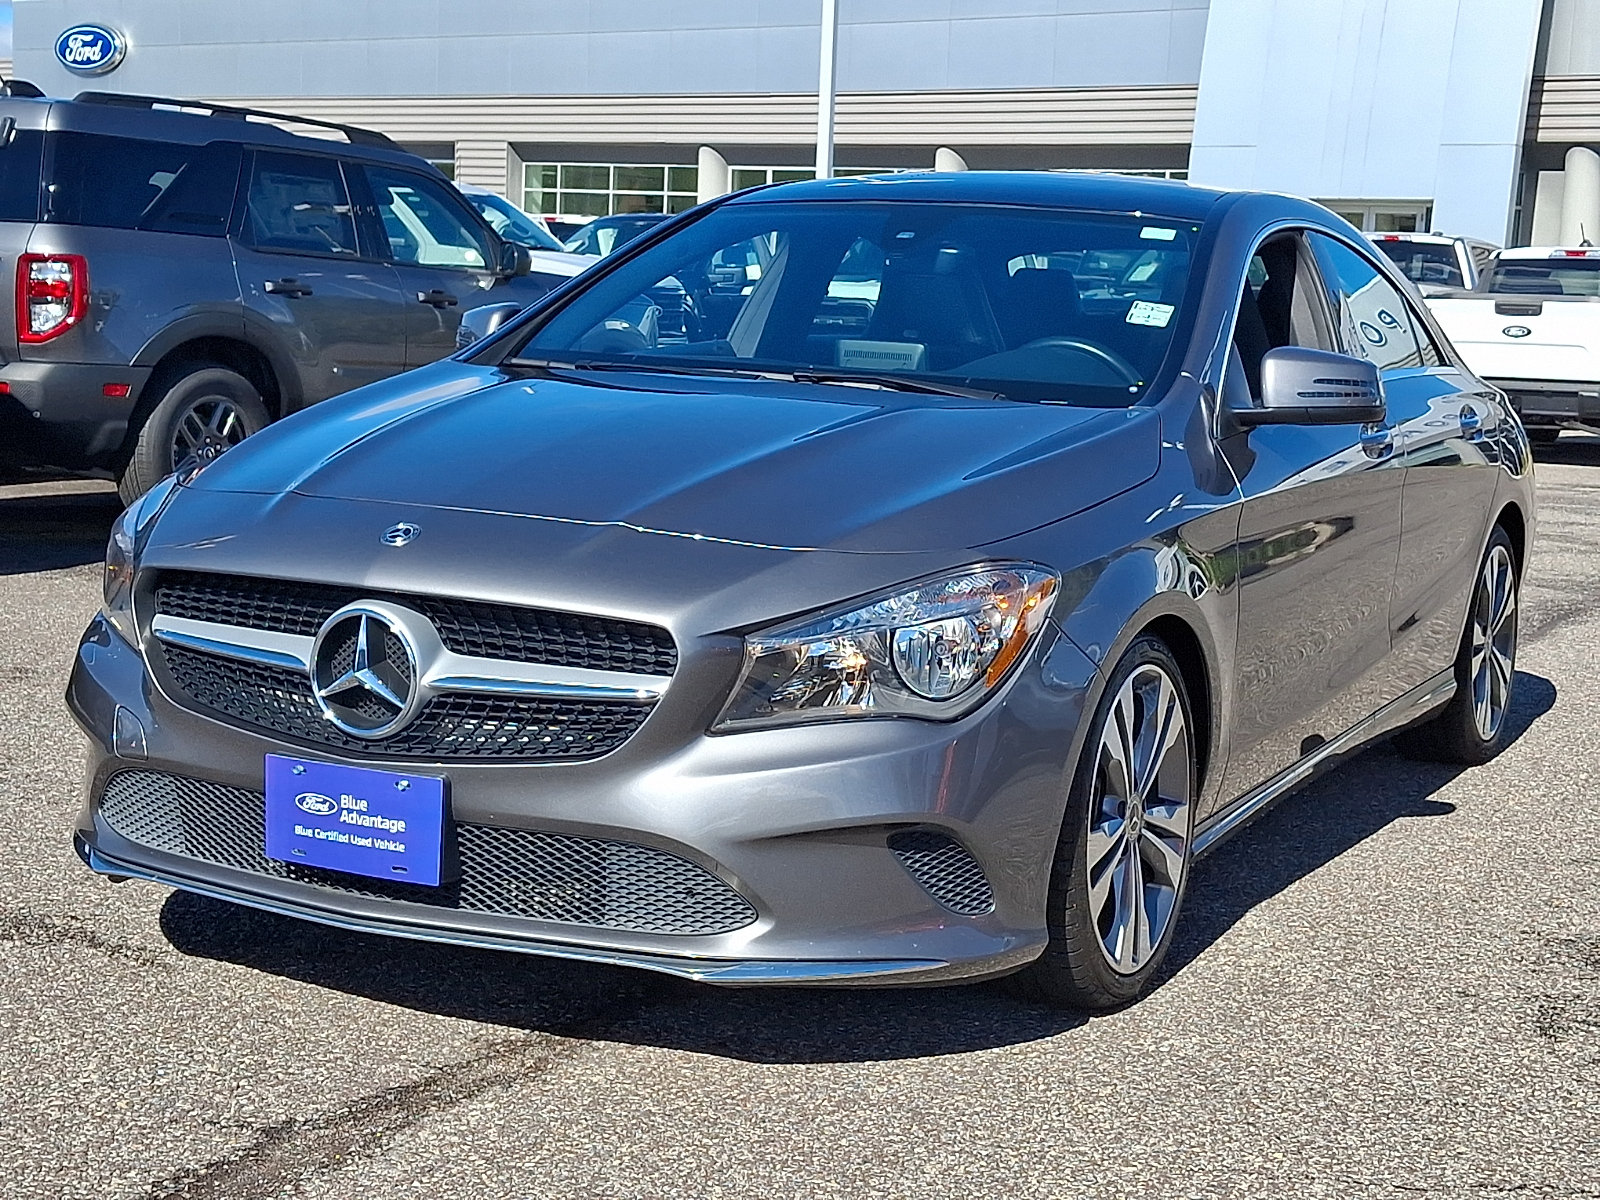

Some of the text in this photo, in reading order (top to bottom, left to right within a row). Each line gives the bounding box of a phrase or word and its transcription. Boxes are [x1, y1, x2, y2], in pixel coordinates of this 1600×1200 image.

[65, 34, 103, 62] Ford
[302, 795, 331, 812] Ford
[340, 794, 368, 812] Blue
[340, 810, 406, 833] Advantage
[294, 825, 406, 852] Blue Certified Used Vehicle
